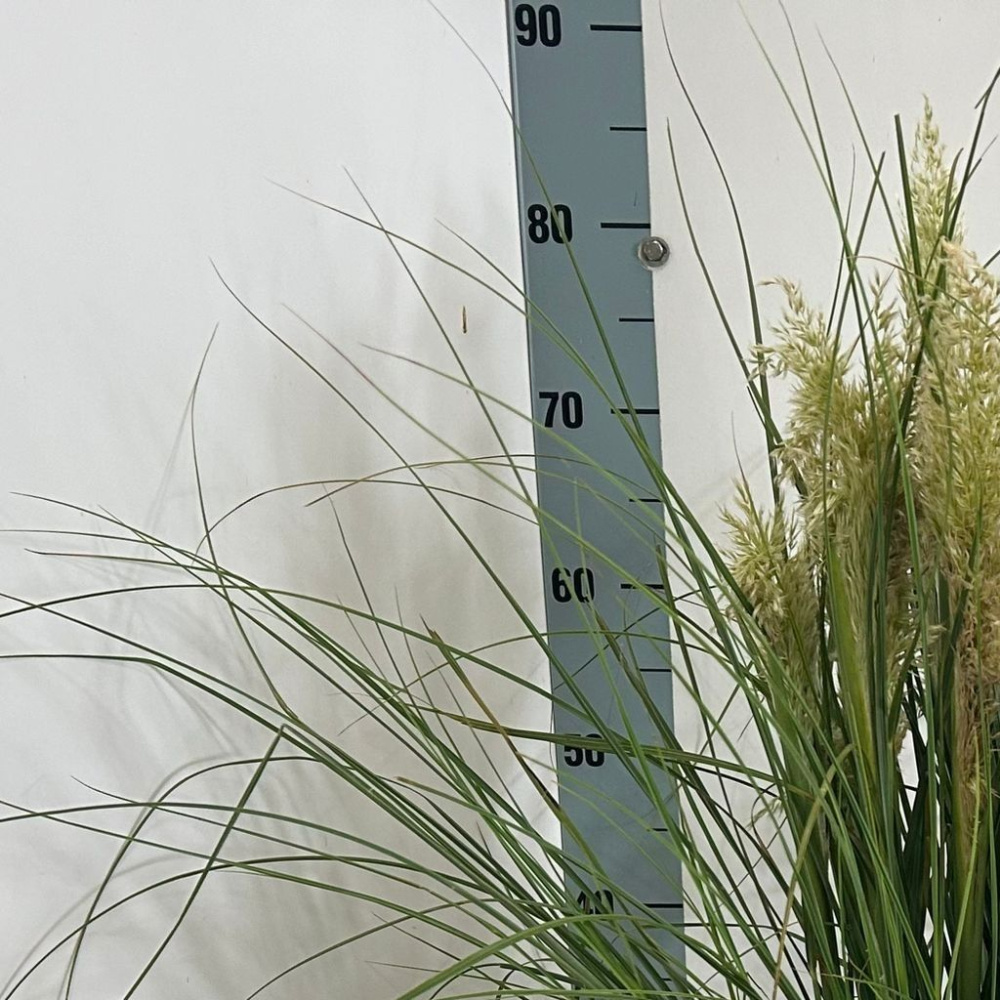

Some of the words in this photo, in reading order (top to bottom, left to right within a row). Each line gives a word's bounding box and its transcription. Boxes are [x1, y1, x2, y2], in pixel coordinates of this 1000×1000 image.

[515, 4, 562, 47] 90
[527, 204, 573, 244] 80
[538, 391, 584, 429] 70
[551, 567, 595, 603] 60
[564, 733, 605, 768] 50
